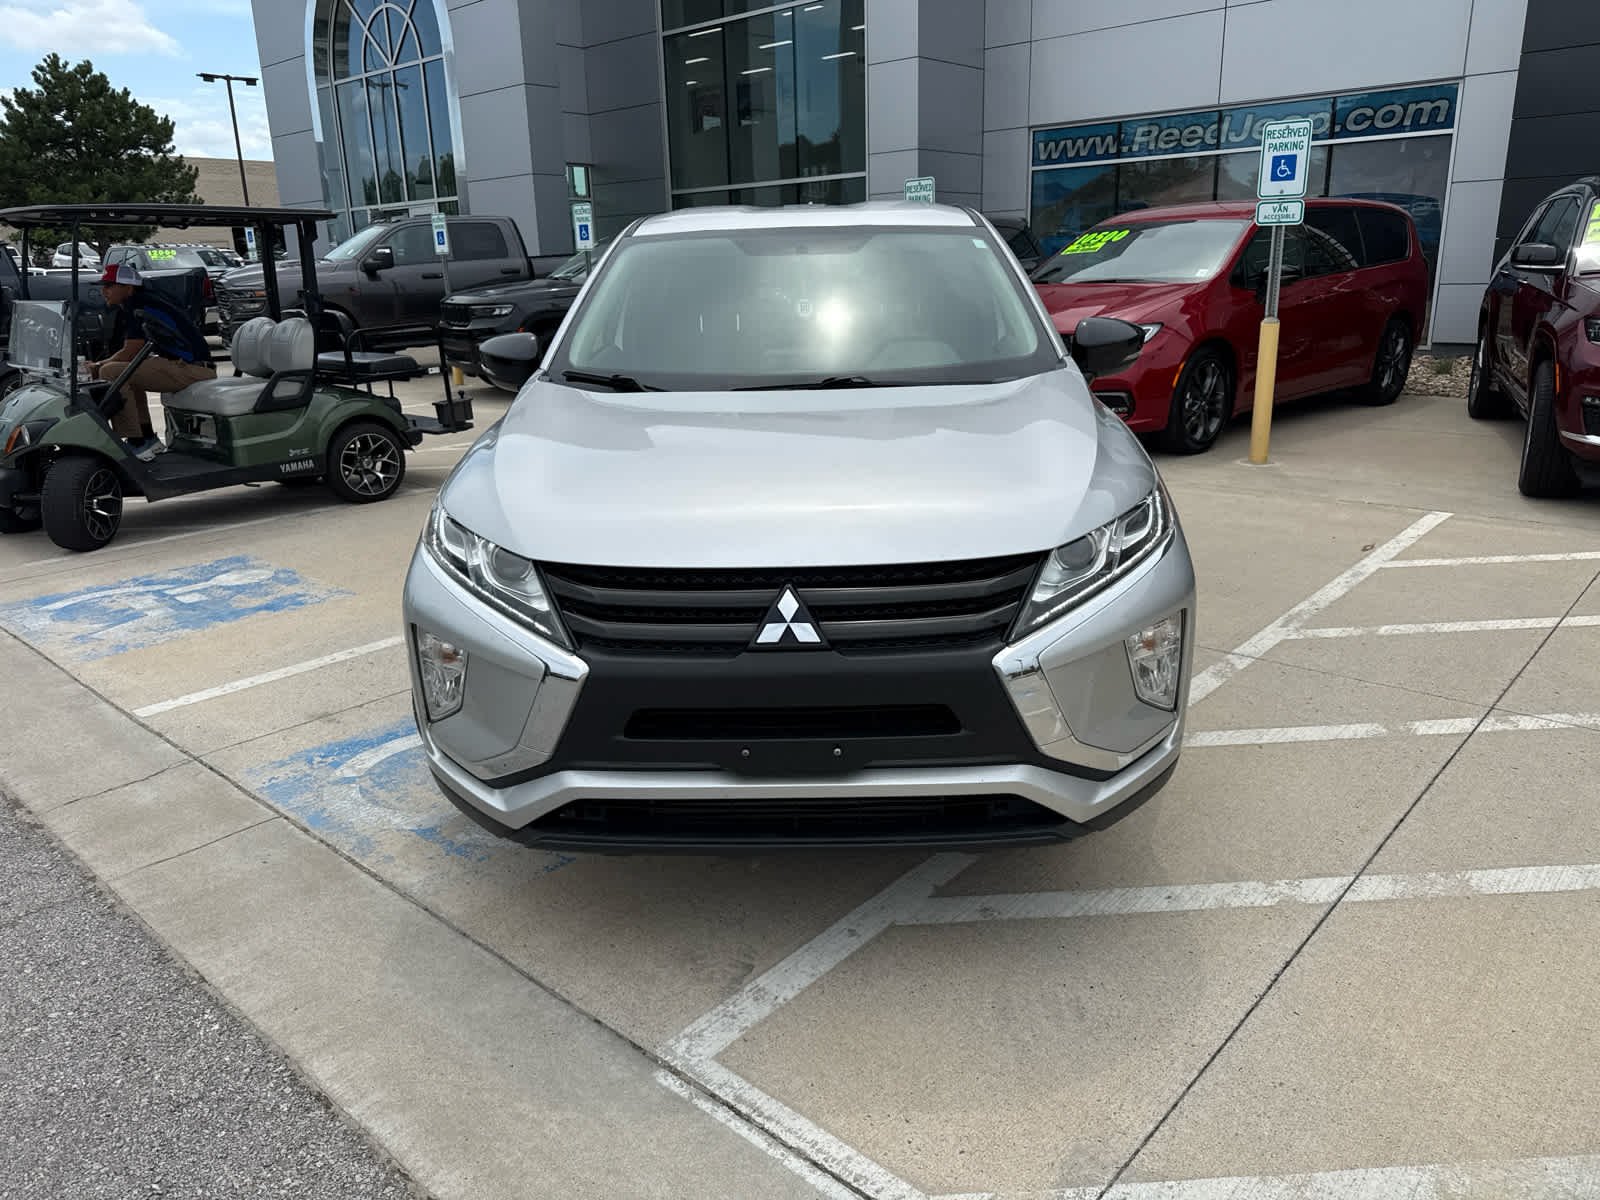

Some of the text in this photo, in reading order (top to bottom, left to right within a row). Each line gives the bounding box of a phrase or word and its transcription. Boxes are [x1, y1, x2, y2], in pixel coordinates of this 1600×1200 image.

[1037, 99, 1450, 161] www.ReedJp.com
[1267, 127, 1309, 140] RESERVED
[1268, 140, 1304, 152] PARKING
[1272, 205, 1289, 213] VAN
[280, 459, 314, 473] YAMAHA
